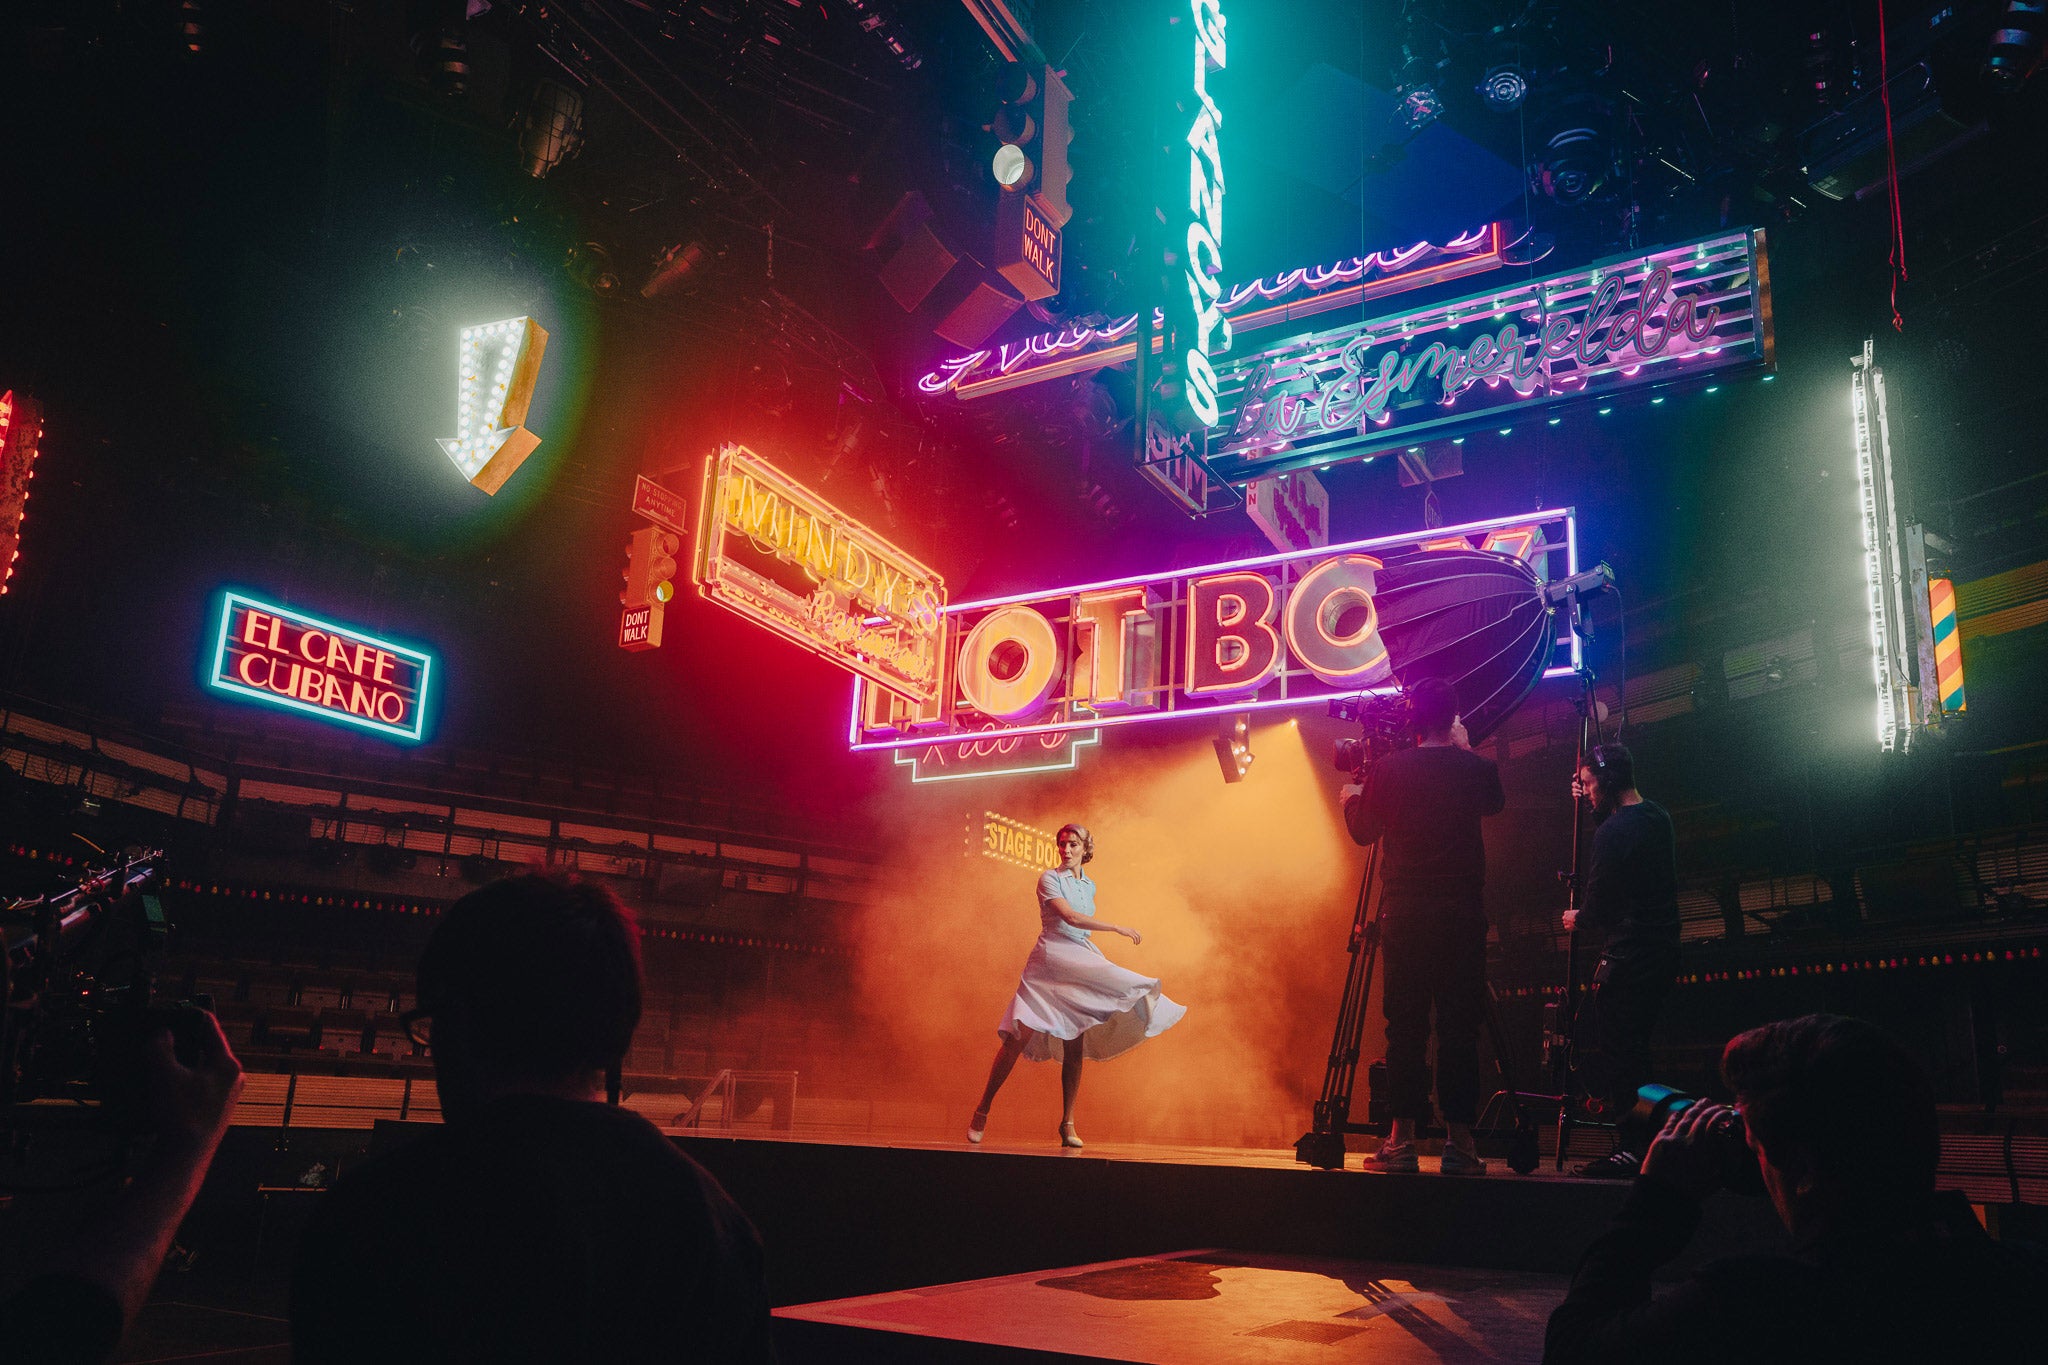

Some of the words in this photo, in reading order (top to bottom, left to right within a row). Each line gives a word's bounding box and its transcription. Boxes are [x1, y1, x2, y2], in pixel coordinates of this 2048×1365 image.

[1026, 207, 1056, 254] DONT
[1024, 234, 1054, 283] WALK
[1219, 363, 1304, 447] La
[1319, 266, 1720, 430] Esmerelda
[641, 482, 651, 493] NO
[645, 496, 676, 518] ANYTIME
[737, 475, 939, 633] MINDY'S
[623, 625, 648, 642] WALK
[625, 610, 650, 627] DONT
[243, 609, 290, 654] EL
[300, 630, 397, 685] CAFE
[239, 653, 404, 723] CUBANO
[988, 817, 1033, 861] STAGE
[1036, 839, 1061, 868] DOO
